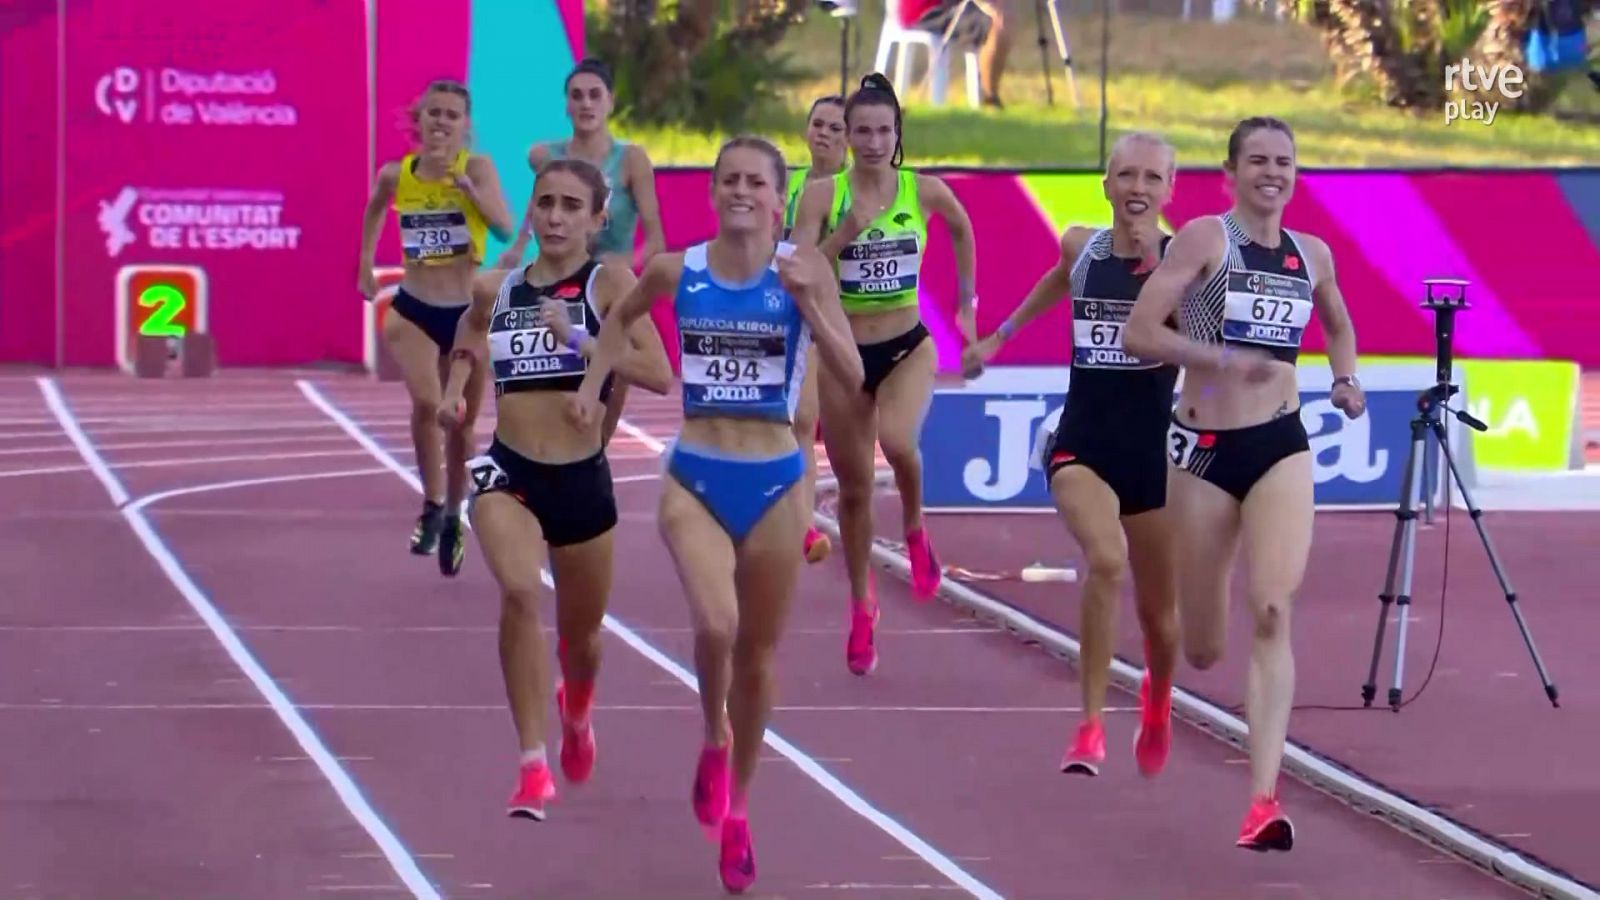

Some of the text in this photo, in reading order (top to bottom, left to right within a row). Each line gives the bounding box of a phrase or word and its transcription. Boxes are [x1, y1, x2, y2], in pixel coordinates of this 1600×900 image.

[161, 68, 277, 97] Diputació
[161, 103, 193, 126] de
[139, 203, 283, 226] COMUNITAT
[150, 226, 301, 249] DE L'ESPORT
[417, 229, 450, 245] 730
[860, 259, 898, 279] 580
[138, 285, 185, 337] 2
[1252, 297, 1294, 323] 672
[510, 330, 557, 355] 670
[1090, 324, 1121, 346] 67
[705, 359, 760, 382] 494
[1171, 432, 1188, 465] 3
